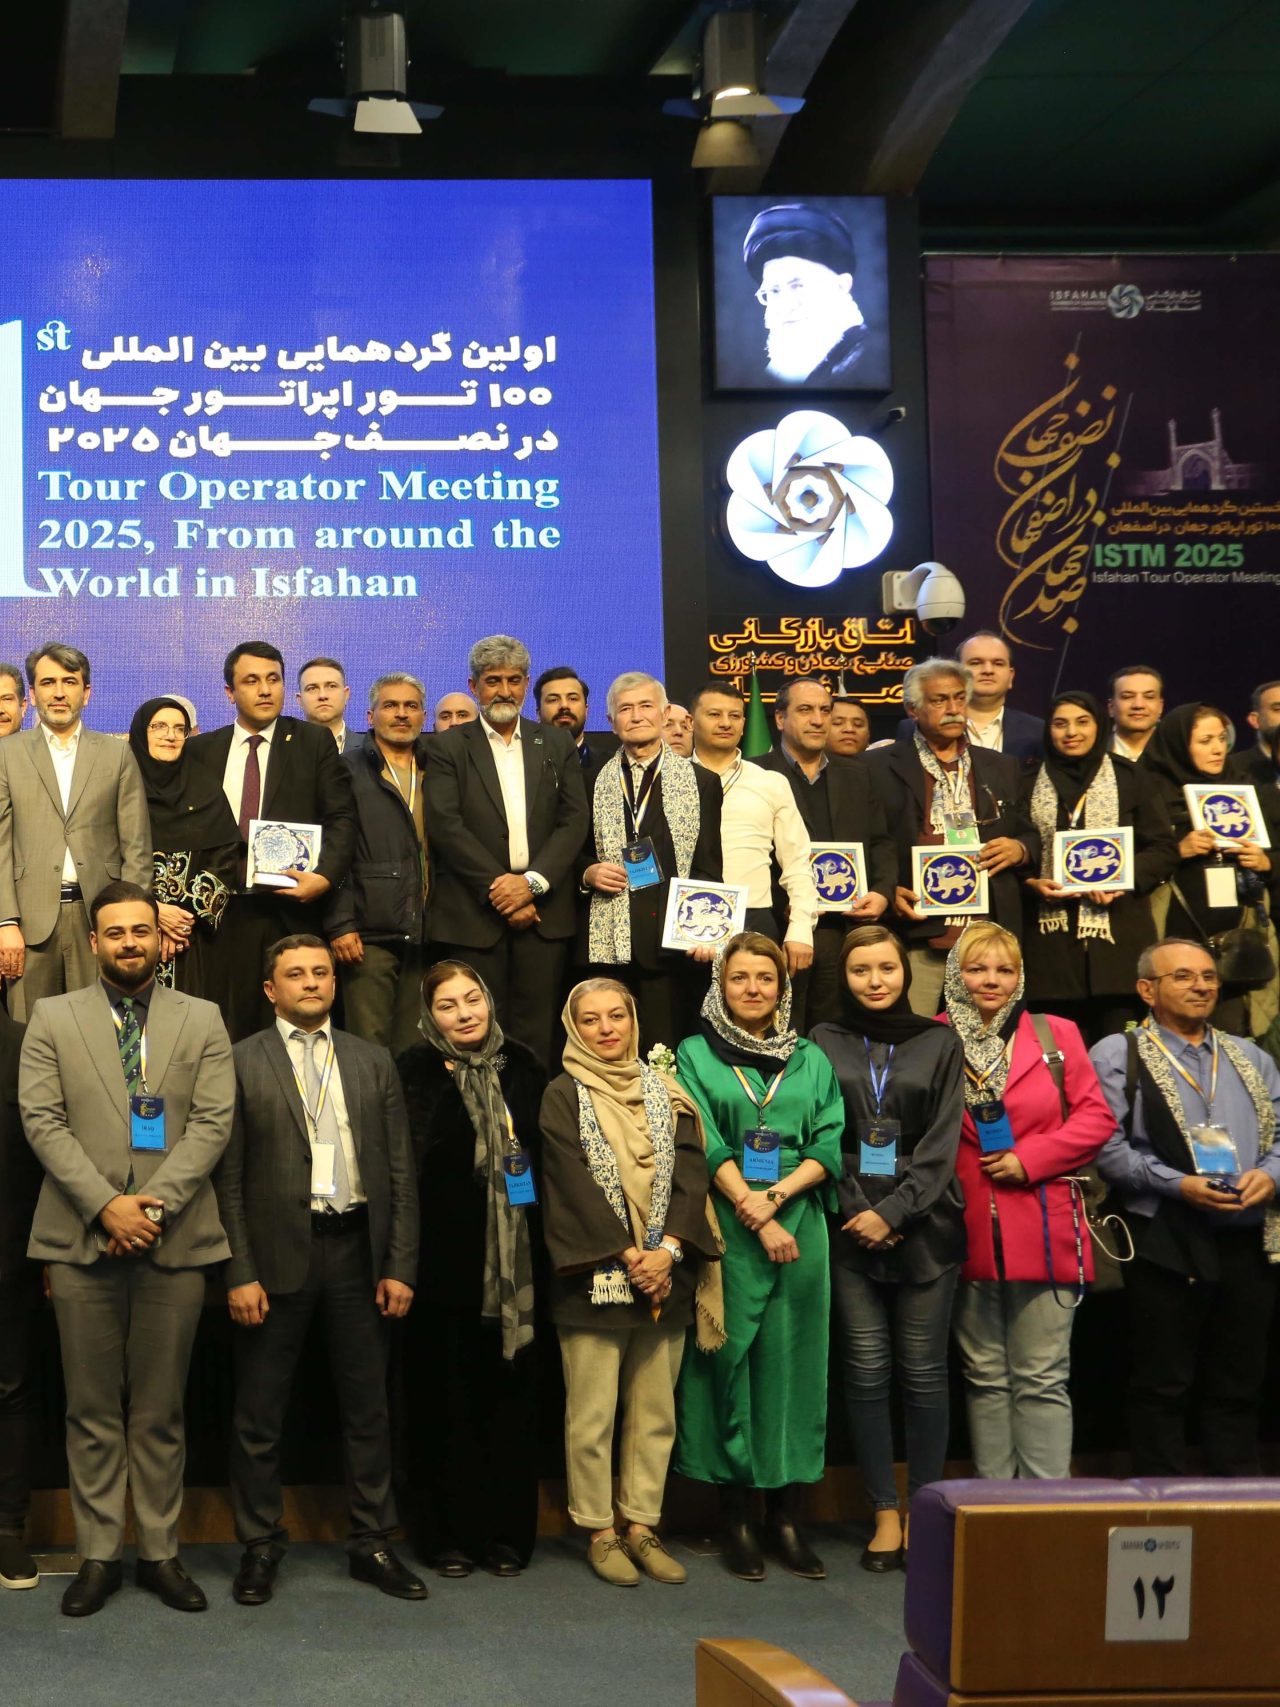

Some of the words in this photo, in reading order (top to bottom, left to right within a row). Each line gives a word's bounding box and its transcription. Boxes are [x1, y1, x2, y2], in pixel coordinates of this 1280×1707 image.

[1050, 290, 1108, 300] ISFAHAN
[81, 335, 194, 370] المللی
[203, 340, 267, 373] بین
[277, 331, 452, 373] گردهمایی
[462, 335, 556, 373] اولین
[39, 379, 180, 417] جهان
[48, 426, 160, 452] ۲۰۲۵
[169, 425, 341, 461] جهان
[345, 421, 509, 451] نصف
[513, 429, 559, 461] در
[37, 471, 147, 501] Tour
[158, 471, 367, 509] Operator
[378, 470, 561, 509] Meeting
[38, 519, 155, 555] 2025,
[173, 519, 296, 549] From
[315, 519, 474, 549] around
[492, 519, 561, 549] the
[1094, 544, 1166, 567] ISTM
[1174, 543, 1244, 567] 2025
[37, 567, 181, 598] World
[195, 567, 237, 598] in
[251, 567, 418, 598] Isfahan
[1092, 571, 1140, 584] Isfahan
[1141, 571, 1171, 583] Tour
[1173, 571, 1229, 585] Operator
[709, 617, 837, 653] بازرگانی
[835, 617, 916, 653] اتاق
[1133, 1575, 1175, 1620] ۱۲
